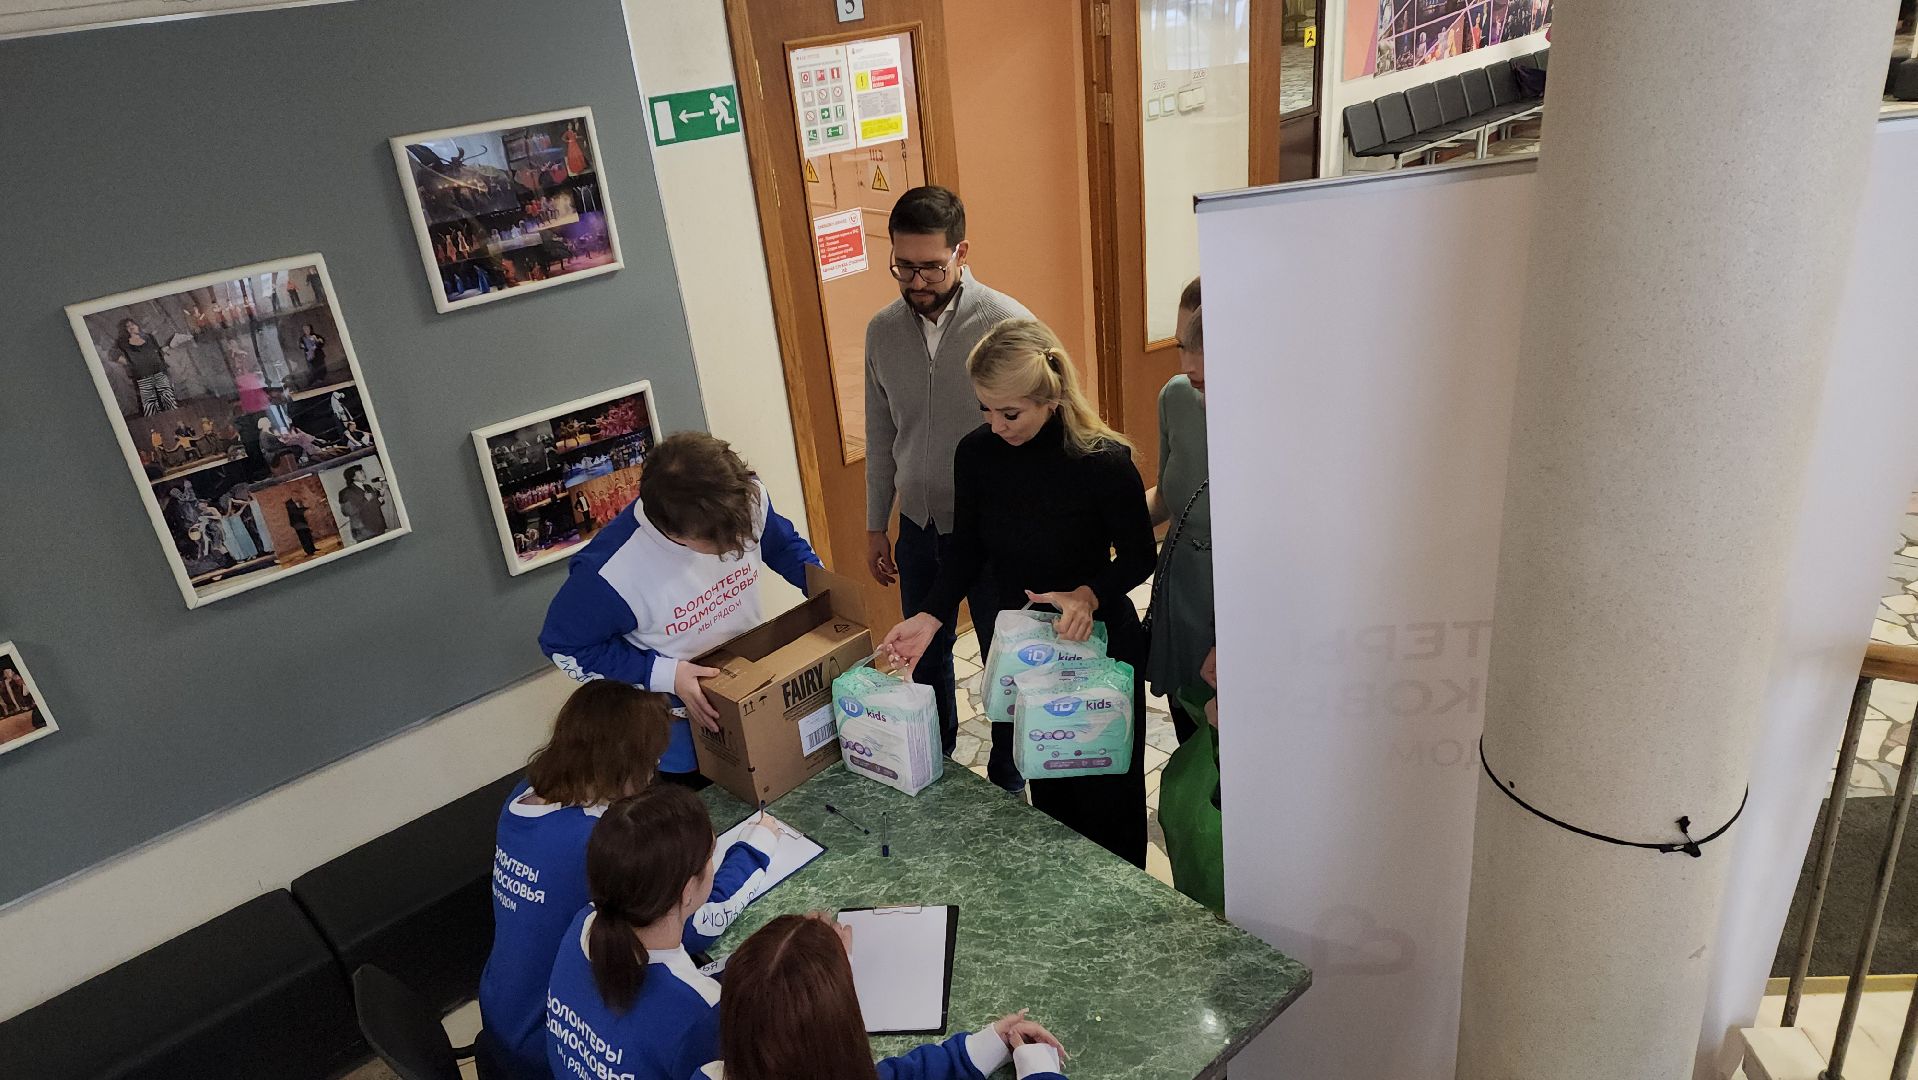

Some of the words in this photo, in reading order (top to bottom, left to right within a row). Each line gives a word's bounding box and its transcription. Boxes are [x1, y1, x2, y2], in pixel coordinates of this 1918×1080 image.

[1306, 30, 1315, 44] 2
[665, 569, 759, 636] ПОДМОСКОВЬЯ
[698, 620, 713, 634] МЫ
[713, 599, 742, 623] РЯДОМ
[782, 662, 825, 709] FAIRY
[866, 707, 887, 723] kids
[1086, 699, 1112, 711] kids
[495, 845, 539, 883] ЛОНТЕРЫ
